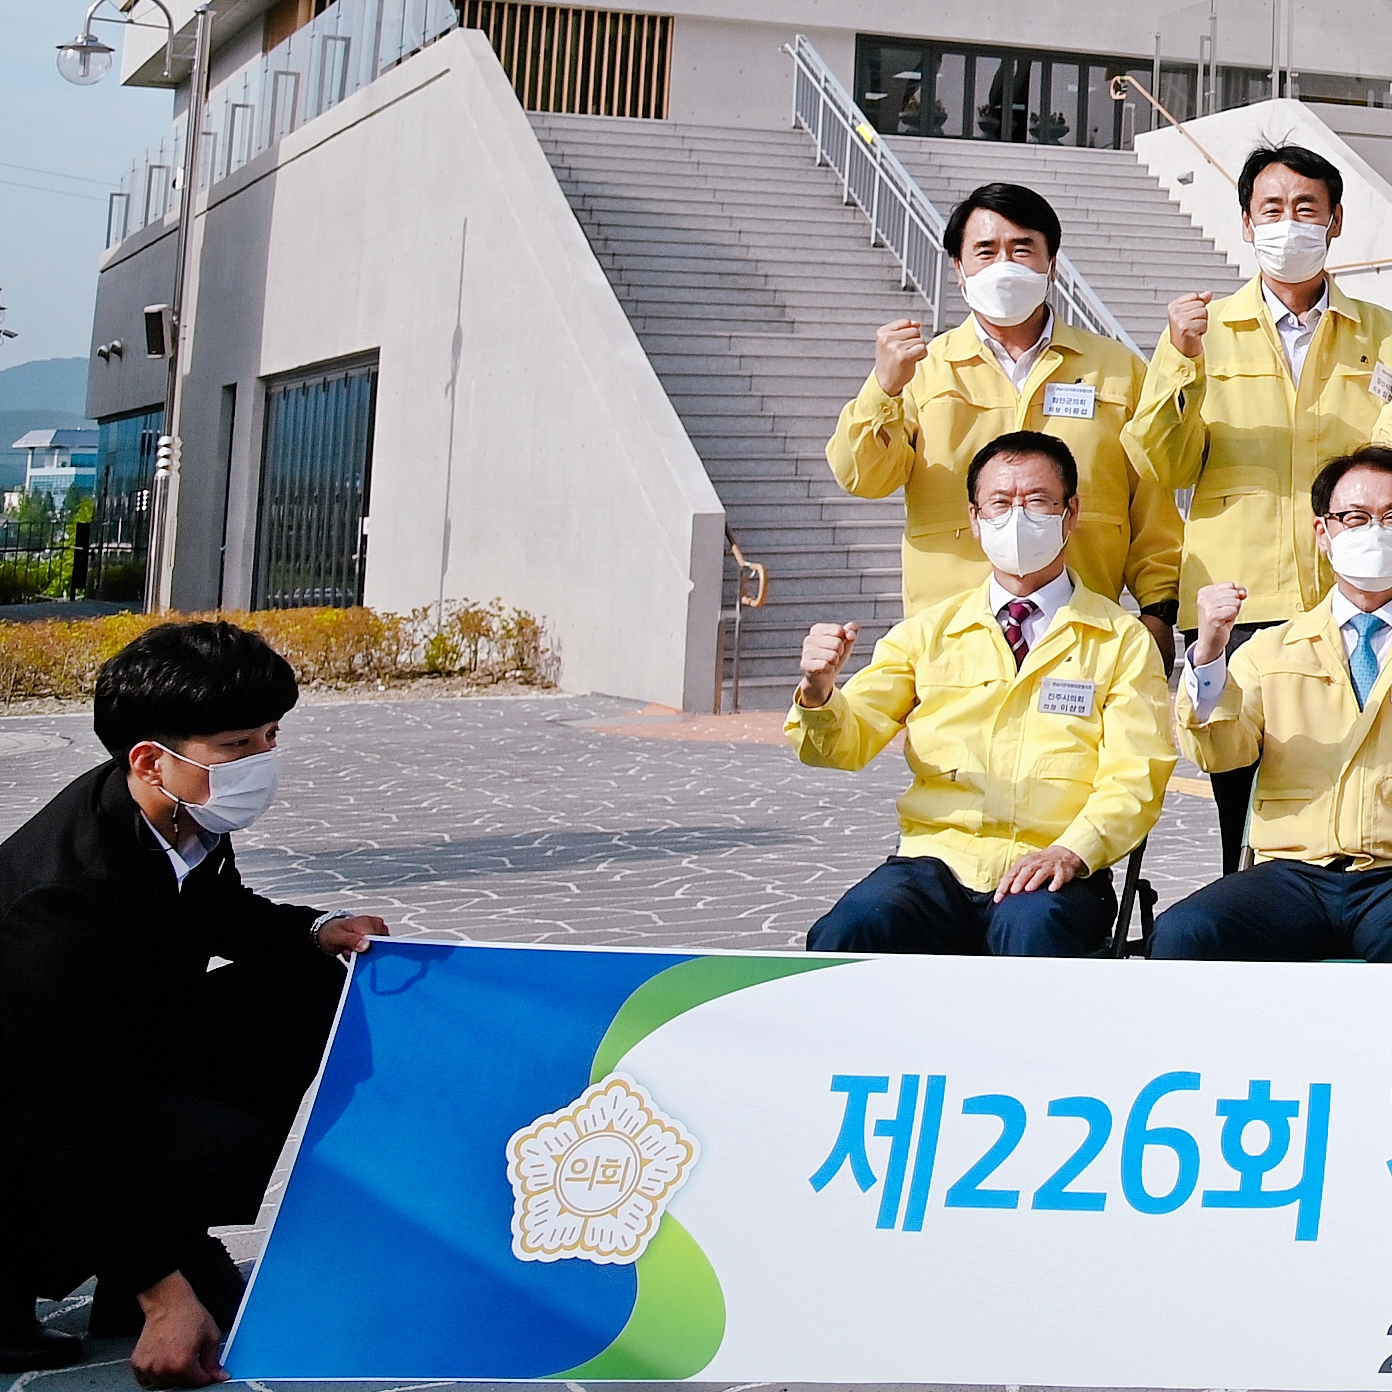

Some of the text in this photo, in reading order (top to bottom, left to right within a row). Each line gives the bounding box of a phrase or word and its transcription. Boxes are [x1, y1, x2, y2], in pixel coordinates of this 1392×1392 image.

[1047, 692, 1085, 703] 진주시의회
[565, 1155, 632, 1192] 의회
[809, 1072, 1331, 1242] 제226회
